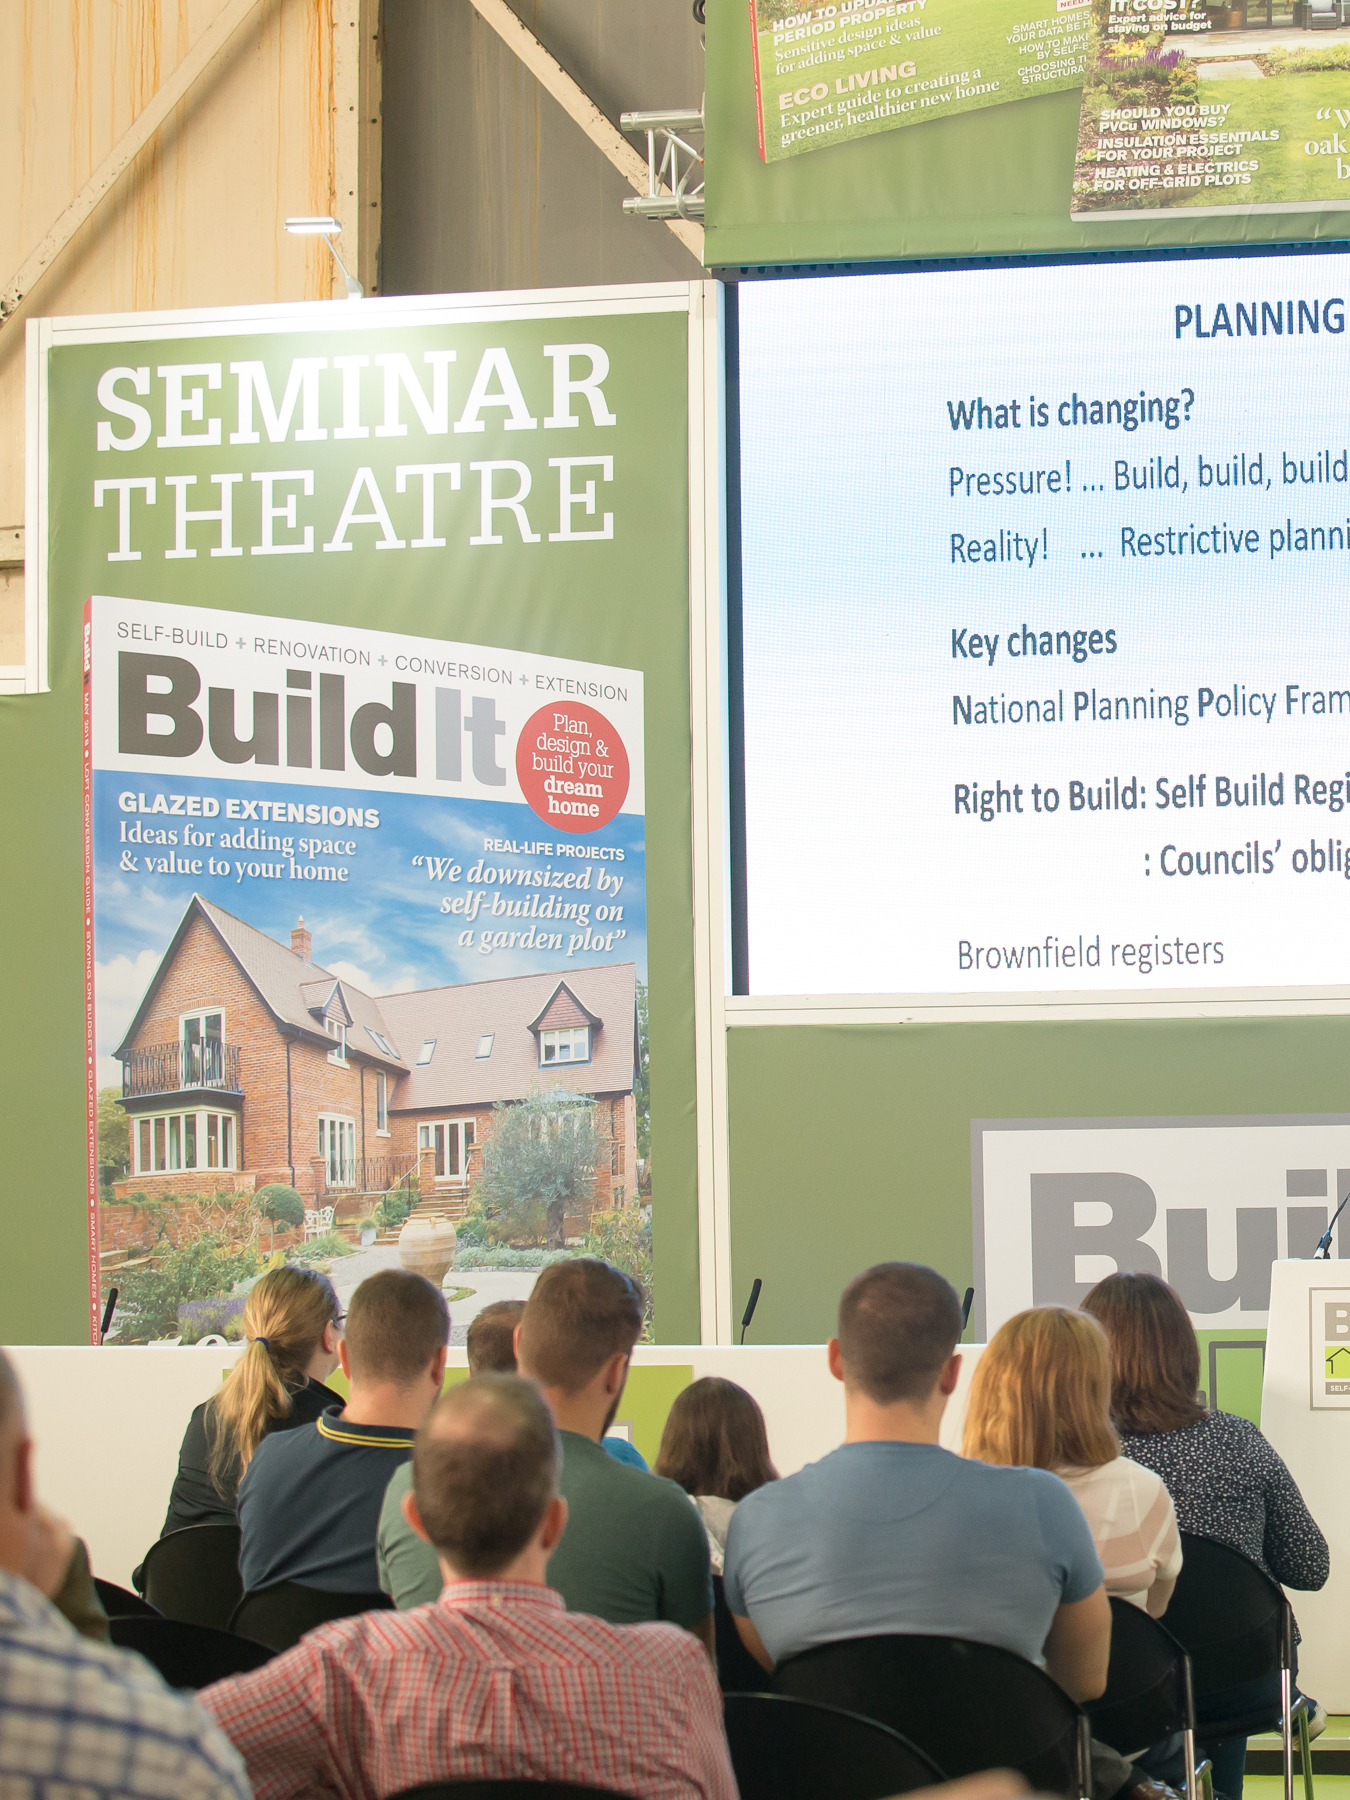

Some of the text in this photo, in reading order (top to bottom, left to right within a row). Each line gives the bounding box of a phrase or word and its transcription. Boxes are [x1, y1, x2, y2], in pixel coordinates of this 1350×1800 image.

[778, 61, 916, 110] ECO LIVING
[780, 68, 982, 128] Expert guide to creating a
[1096, 144, 1243, 162] FOR YOUR PROJECT
[1098, 130, 1280, 150] INSULATION ESSENTIALS
[1304, 133, 1348, 156] oak
[1175, 298, 1345, 339] PLANNING
[97, 343, 616, 451] SEMINAR
[947, 388, 1194, 431] What is changing?
[950, 449, 1348, 496] Pressure! Build, build, build
[94, 455, 614, 561] THEATRE
[951, 528, 1048, 568] Reality!
[1121, 522, 1259, 557] Restrictive
[117, 622, 628, 702] SELF-BUILD RENOVATION CONVERSION EXTENSION
[951, 623, 1118, 666] Key changes
[118, 651, 506, 786] Build It
[953, 690, 1063, 724] National
[1074, 688, 1189, 726] Planning
[1199, 684, 1276, 723] Policy
[537, 732, 609, 757] design &
[553, 713, 592, 738] Plan,
[532, 752, 614, 779] build your
[544, 776, 603, 797] dream
[954, 780, 1023, 822] Right
[1032, 783, 1060, 813] to
[1070, 776, 1146, 811] Build:
[1156, 774, 1207, 808] Self
[1216, 772, 1284, 806] Build
[119, 792, 380, 828] GLAZED EXTENSIONS
[548, 796, 599, 817] home
[120, 821, 357, 859] Ideas for adding space
[484, 838, 625, 861] REAL-LIFE PROJECTS
[1160, 839, 1281, 876] Councils’
[120, 850, 349, 883] & value to your home
[412, 855, 624, 897] “We downsized by
[440, 891, 623, 926] self-building on
[458, 926, 626, 956] a garden plot”
[959, 935, 1224, 974] Brownfield registers
